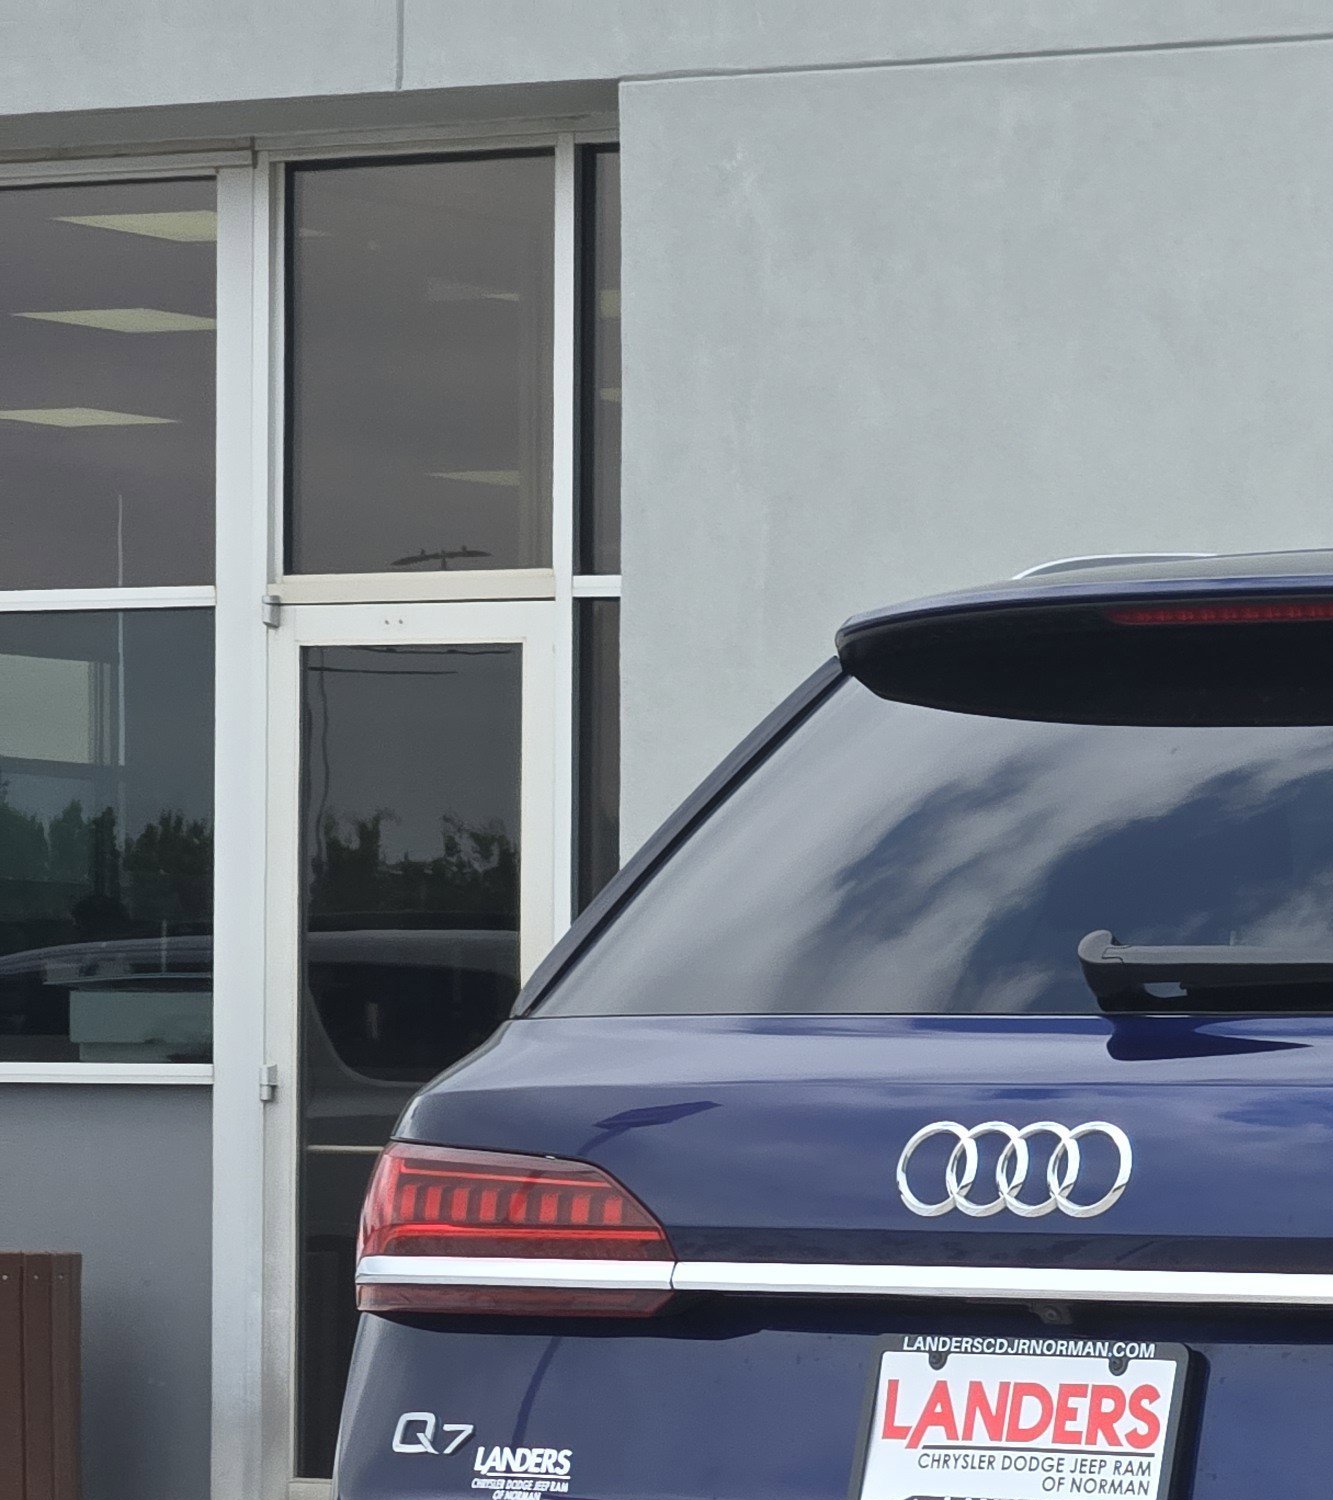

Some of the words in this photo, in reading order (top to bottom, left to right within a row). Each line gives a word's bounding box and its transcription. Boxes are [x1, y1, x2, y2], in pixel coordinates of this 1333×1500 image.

[903, 1336, 1156, 1359] LANDERSCDJRNORMAN.COM
[881, 1379, 1162, 1450] LANDERS
[392, 1411, 474, 1455] Q7
[474, 1446, 573, 1475] LANDERS
[917, 1453, 997, 1471] CHRYSLER
[1000, 1455, 1066, 1474] DODGE
[1070, 1457, 1109, 1476] JEEP
[1112, 1460, 1152, 1478] RAM
[1041, 1476, 1065, 1493] OF
[1070, 1477, 1150, 1496] NORMAN
